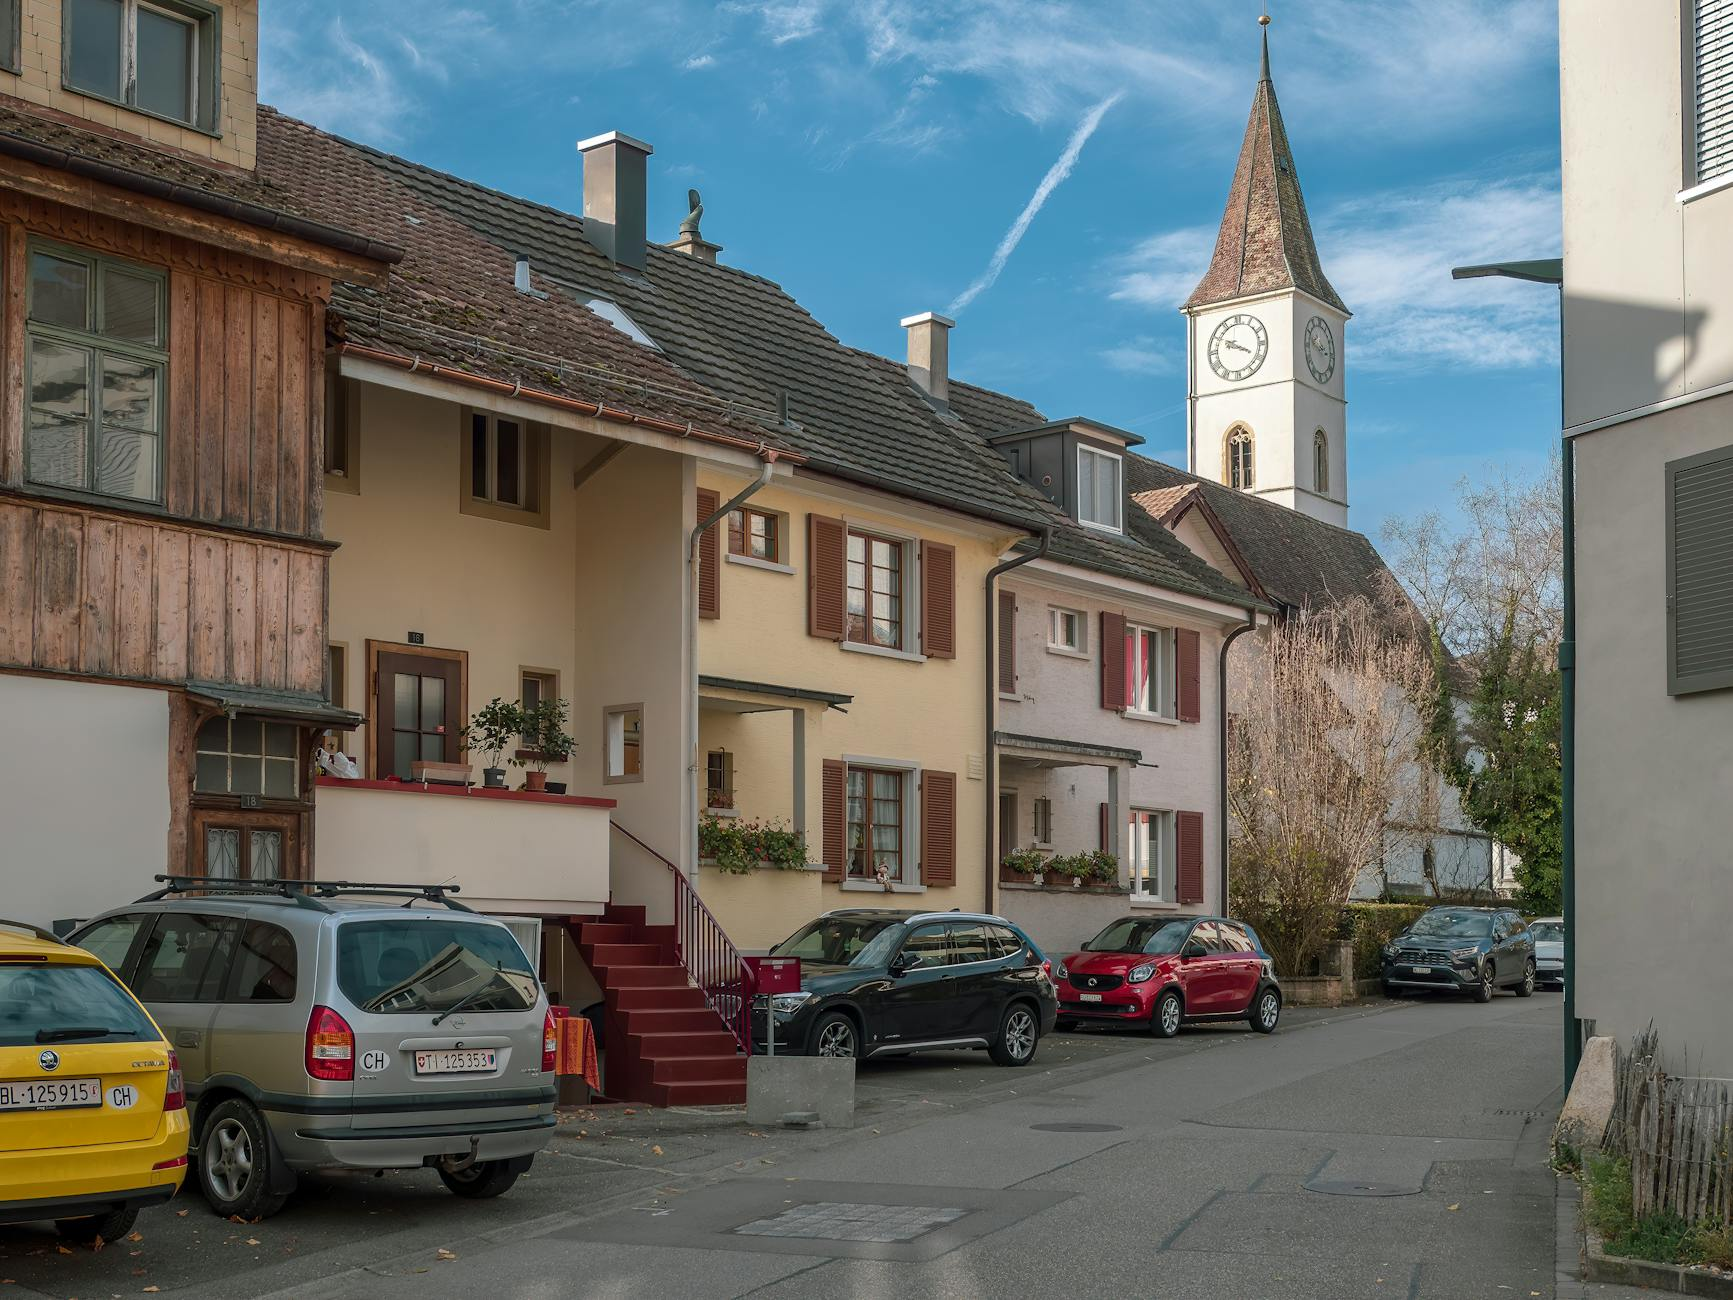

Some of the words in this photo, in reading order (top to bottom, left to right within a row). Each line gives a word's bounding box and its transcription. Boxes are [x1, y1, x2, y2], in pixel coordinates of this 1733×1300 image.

[247, 796, 257, 806] 18
[363, 1052, 384, 1069] CH
[113, 1087, 132, 1106] CH
